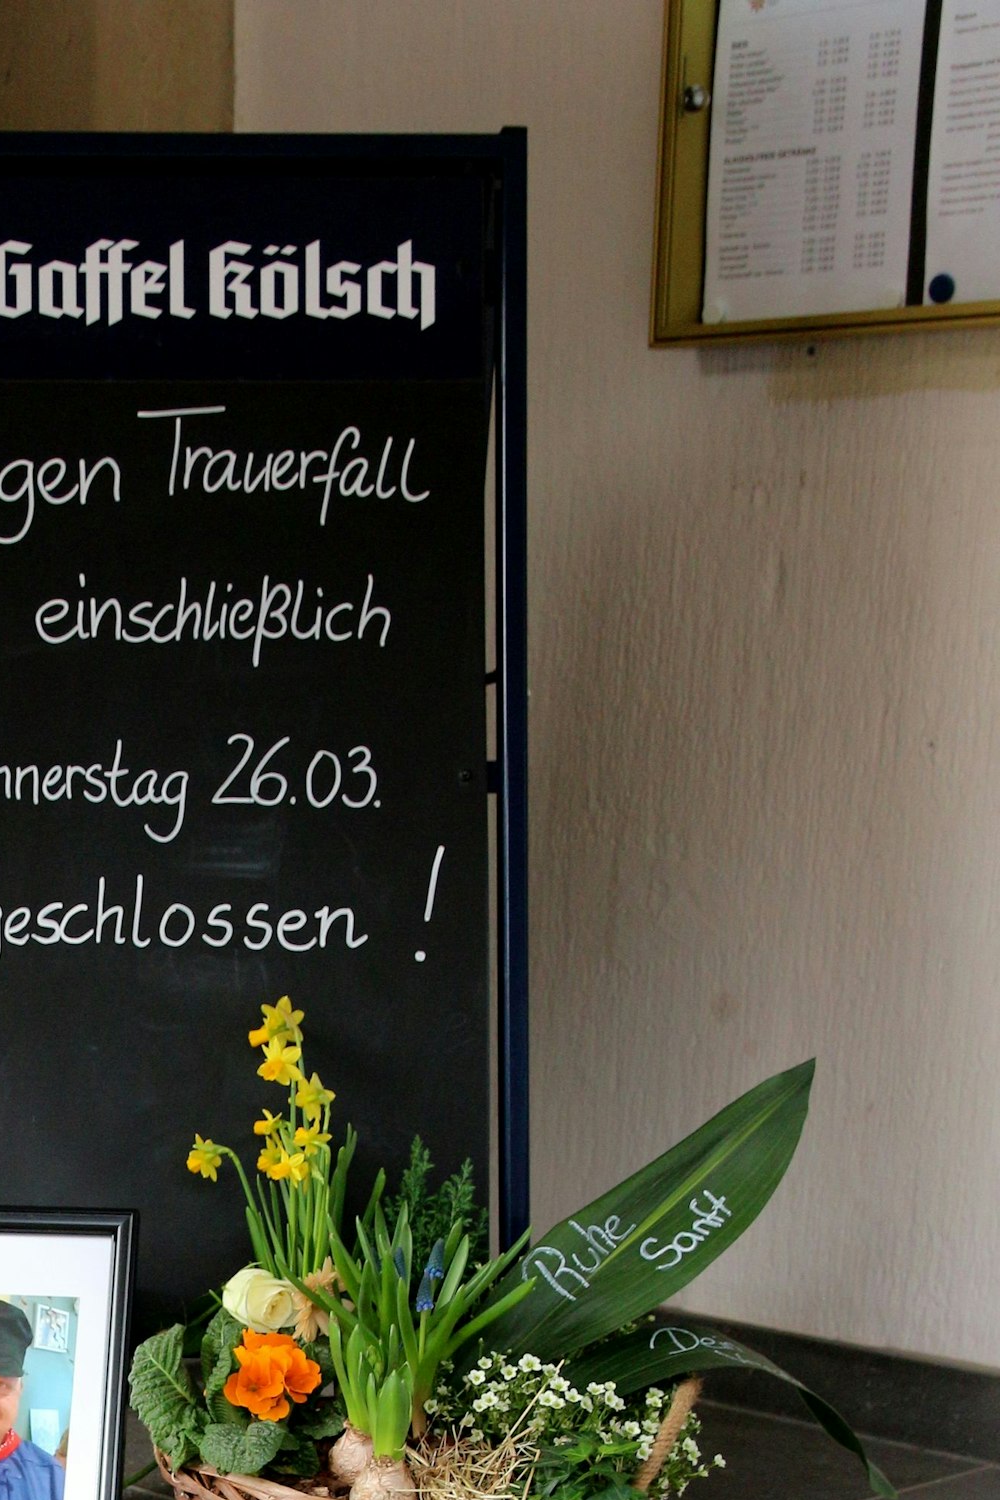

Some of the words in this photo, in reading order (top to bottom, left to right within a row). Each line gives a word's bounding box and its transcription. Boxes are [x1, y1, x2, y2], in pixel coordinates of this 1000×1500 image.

[209, 239, 436, 331] Kölsch
[137, 406, 430, 526] Trauerfall
[35, 573, 391, 668] einschließlich
[211, 733, 381, 809] 26.03.
[521, 1215, 637, 1301] Ruhe
